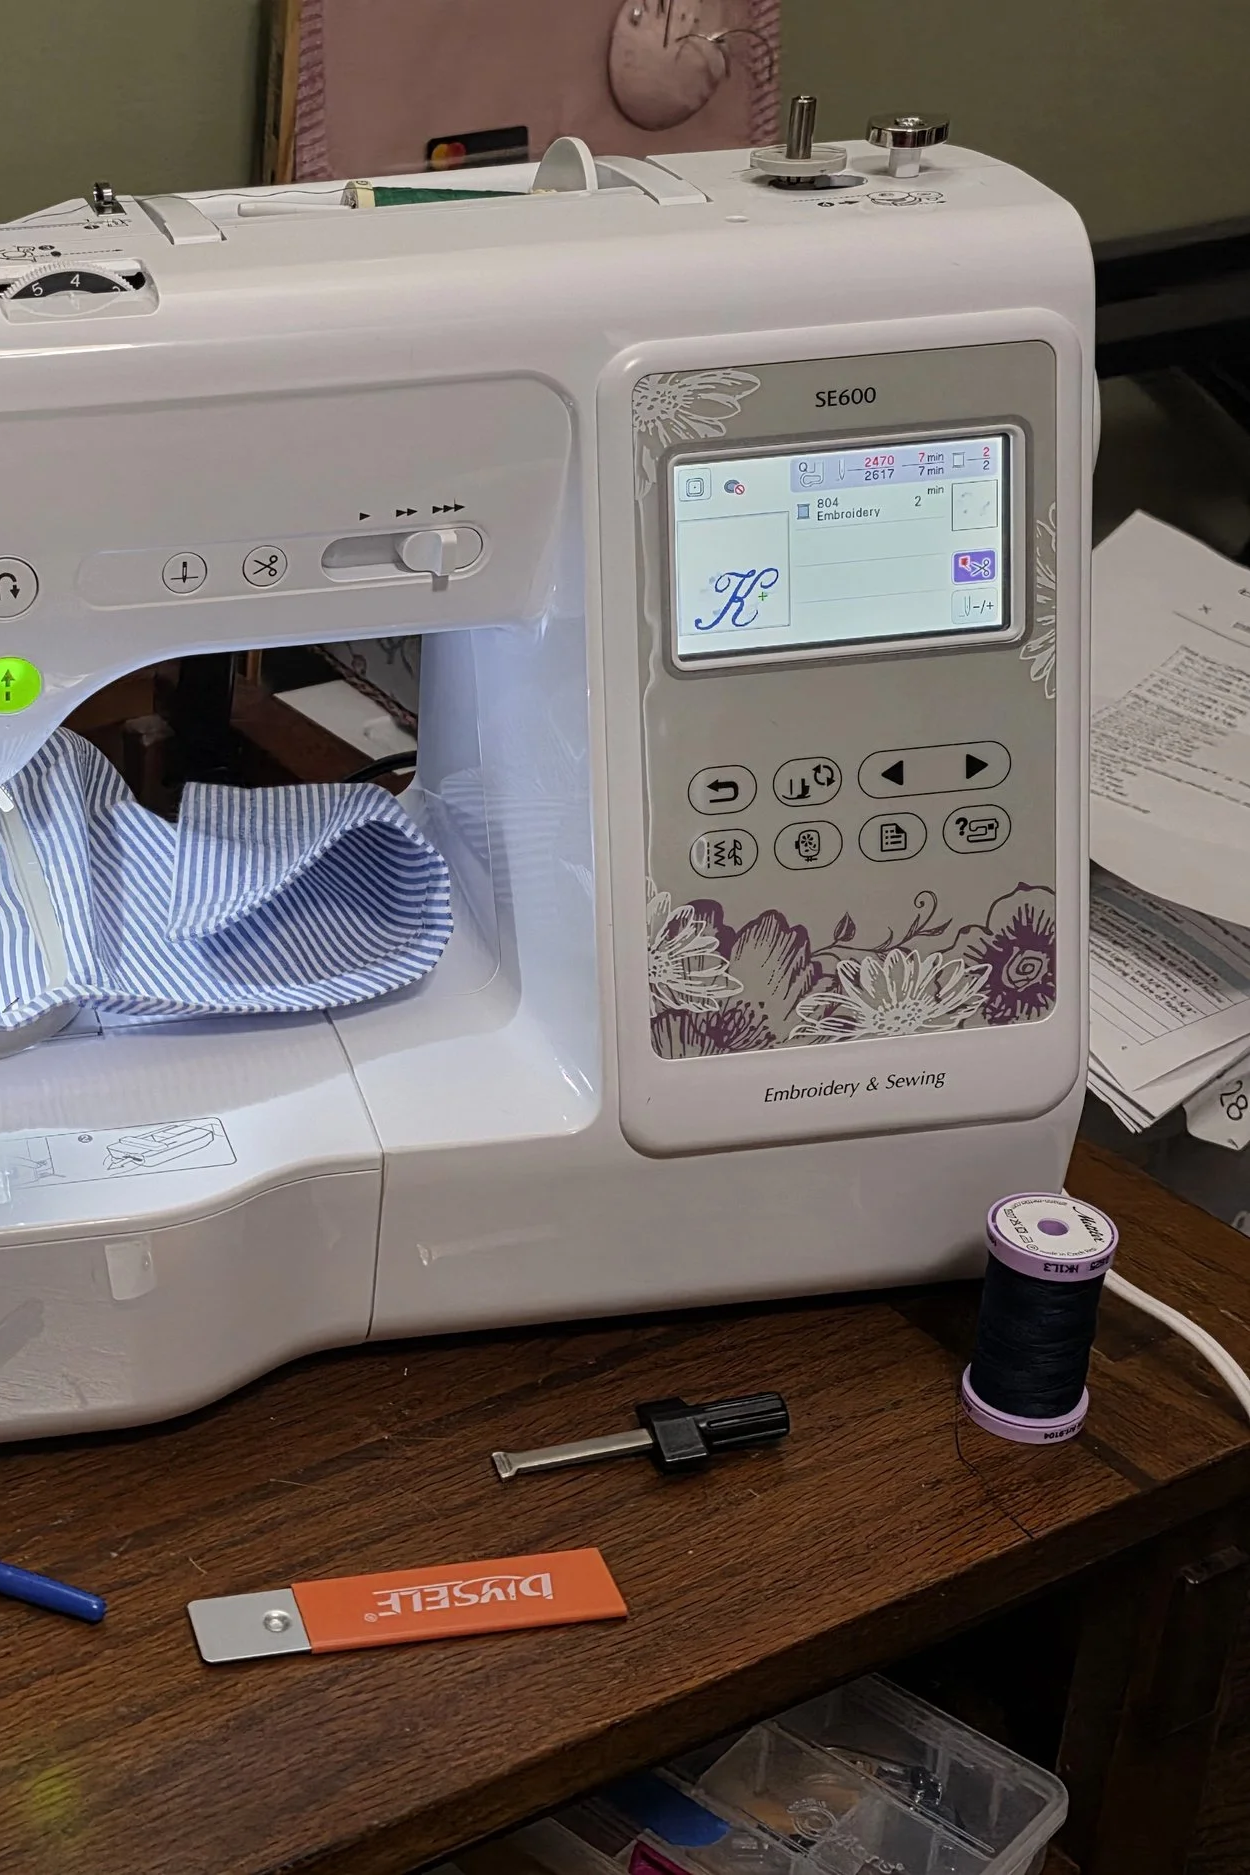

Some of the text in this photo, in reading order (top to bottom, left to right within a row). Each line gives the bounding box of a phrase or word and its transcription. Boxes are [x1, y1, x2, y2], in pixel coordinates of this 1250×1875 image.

[31, 274, 80, 297] 5 4
[815, 387, 877, 408] SE600
[918, 453, 944, 463] 7 min
[983, 447, 990, 457] 2
[864, 455, 895, 468] 2470
[983, 460, 990, 470] 2
[864, 469, 895, 481] 2617
[918, 466, 944, 476] 7 min
[927, 485, 944, 495] min
[817, 496, 922, 508] 804 2
[817, 507, 880, 521] Embroidery
[764, 1070, 946, 1102] Embroidery & Sewing
